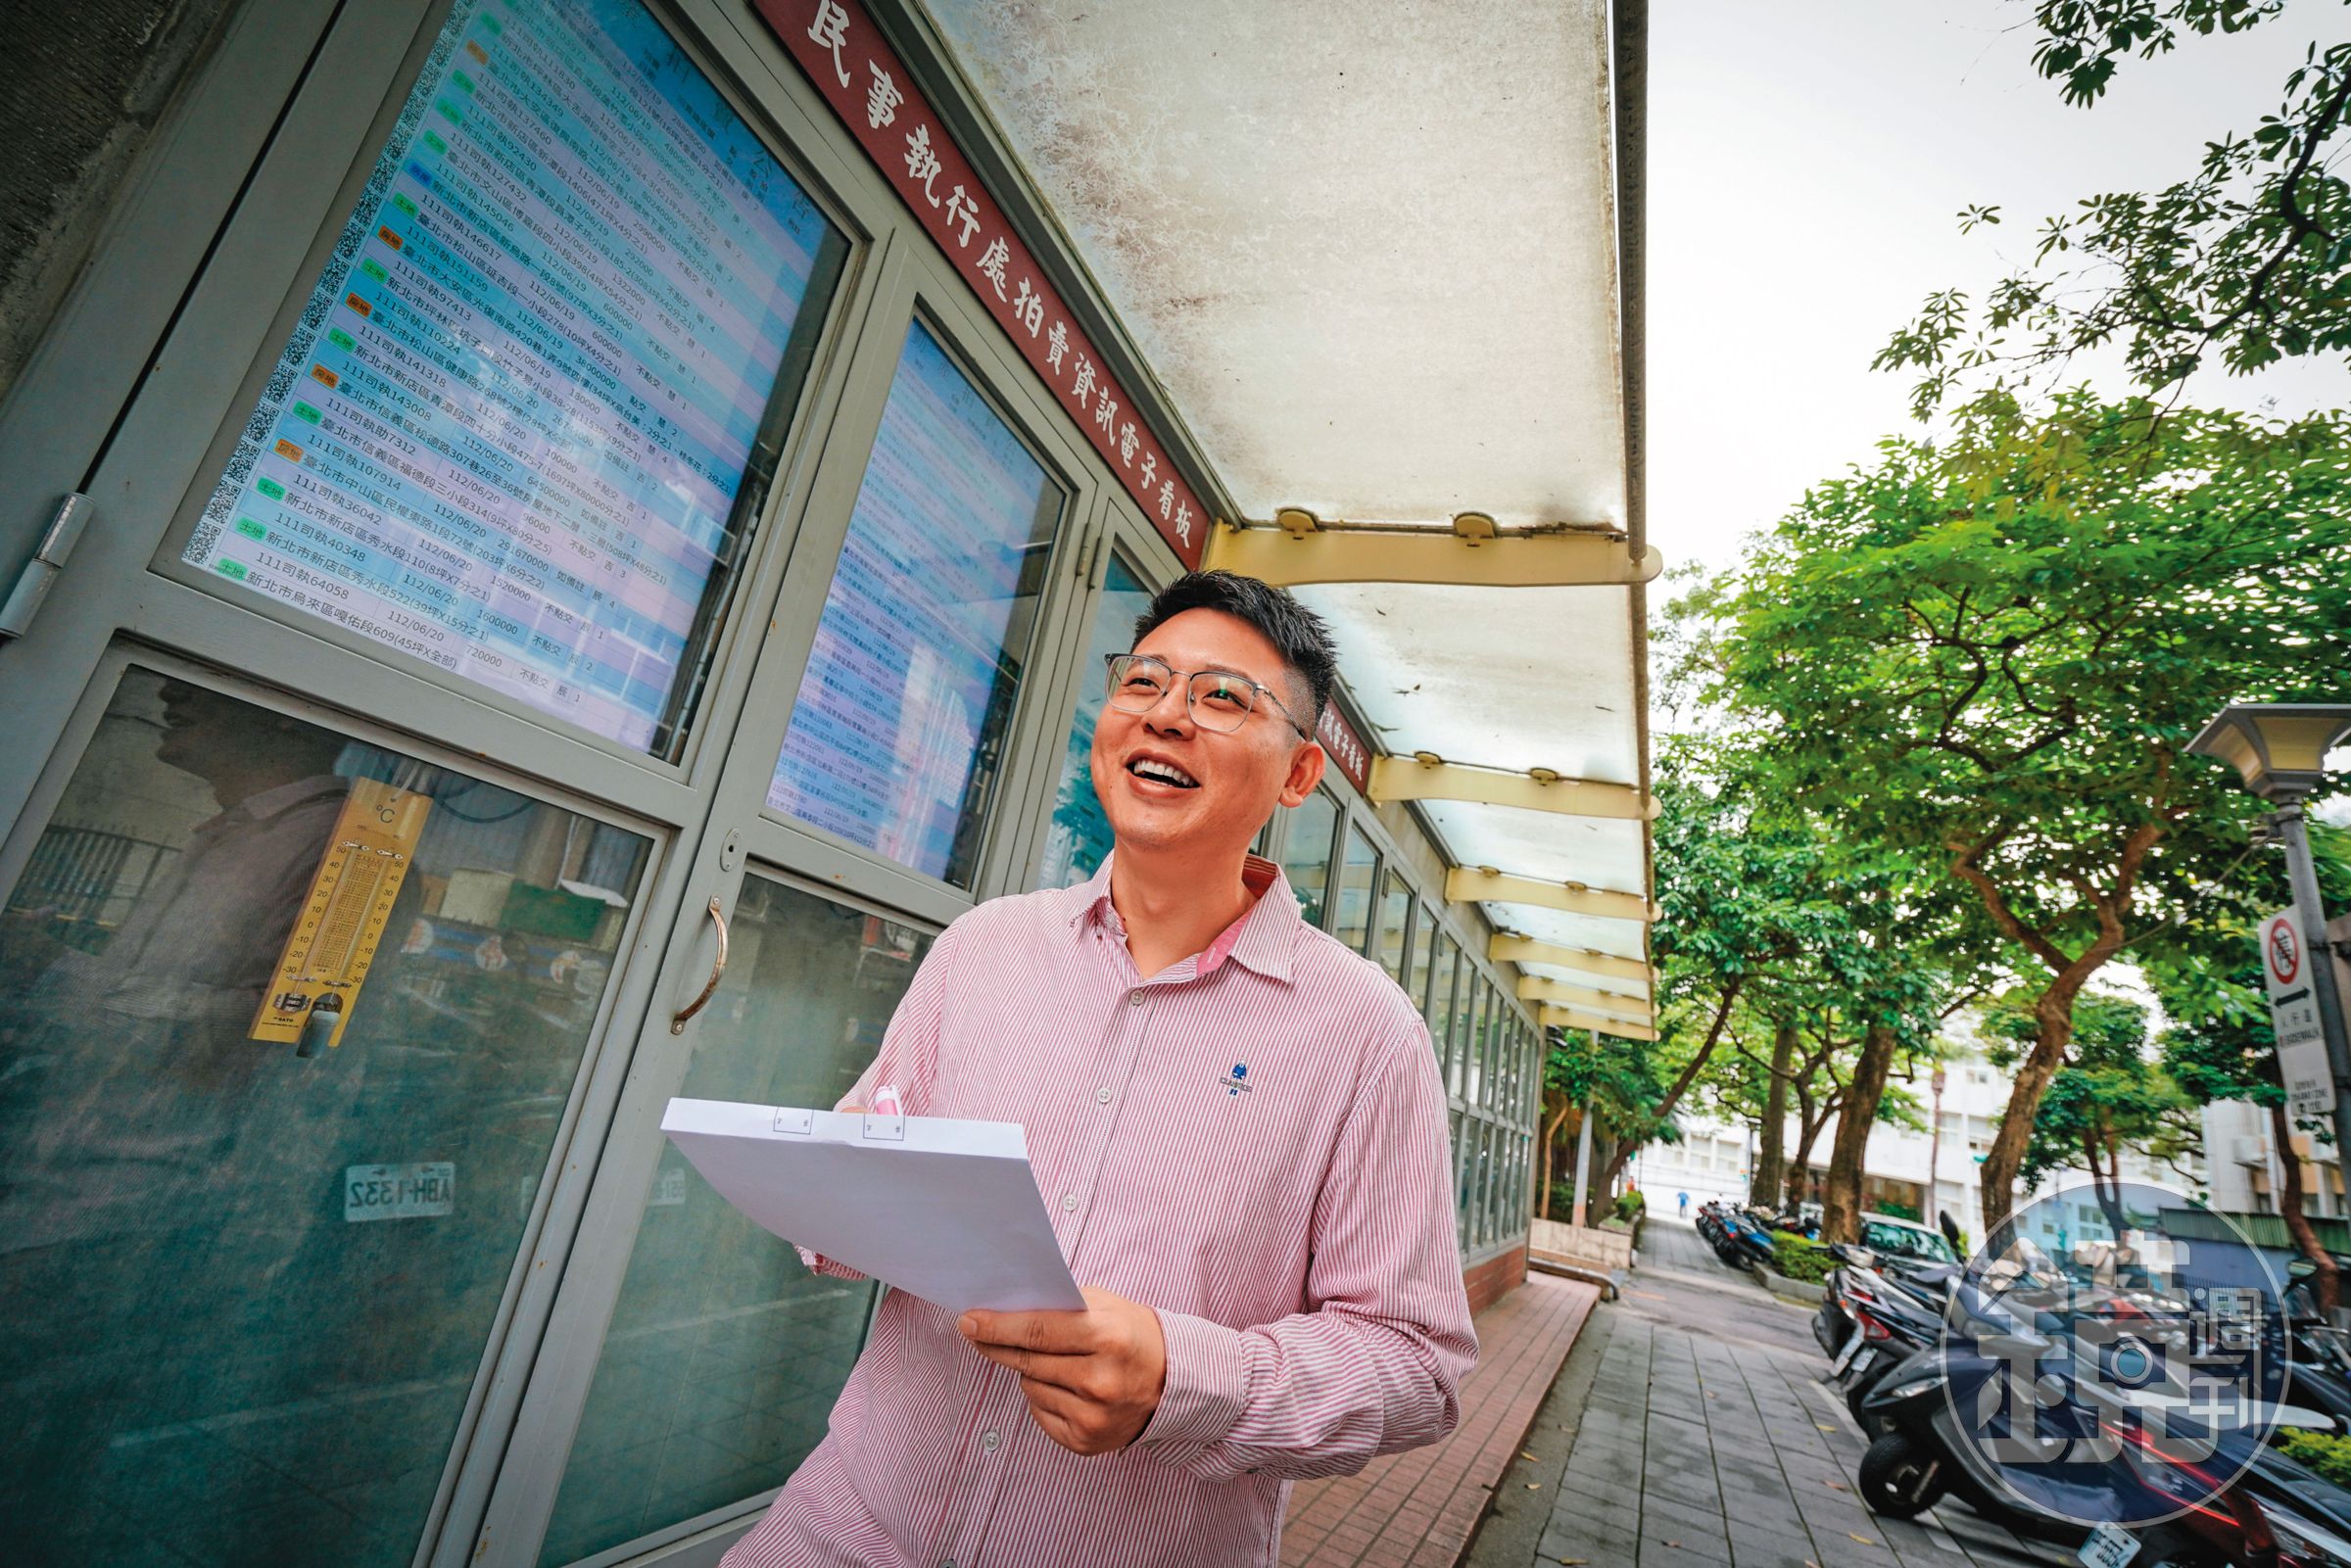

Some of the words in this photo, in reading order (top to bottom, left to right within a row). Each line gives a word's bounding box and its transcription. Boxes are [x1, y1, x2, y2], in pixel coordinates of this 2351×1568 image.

[405, 224, 489, 294] 111司執151159
[514, 309, 564, 352] 112/06/19
[574, 354, 617, 391] 38000000
[419, 192, 503, 263] 111司執146617
[527, 279, 576, 322] 112/06/19
[590, 329, 623, 359] 600000
[434, 161, 515, 234] 111司執145046
[540, 250, 587, 294] 112/06/19
[601, 301, 633, 332] 600000
[552, 221, 599, 266] 112/06/19
[807, 0, 1195, 548] 民事執行處拍賣資訊電子看板
[357, 324, 448, 390] 111司執141318
[475, 402, 527, 442] 112/06/20
[543, 447, 578, 474] 100000
[591, 477, 620, 502] 不點交
[374, 290, 461, 356] 111司執110224
[489, 369, 540, 411] 112/06/20
[393, 259, 472, 323] 111司執97413
[502, 339, 552, 381] 112/06/19
[568, 387, 601, 416] 180000
[306, 432, 403, 493] 111司執107914
[432, 501, 487, 540] 112/06/20
[324, 396, 417, 457] 111司執助7312
[447, 468, 501, 506] 112/06/20
[520, 511, 552, 535] 96000
[567, 538, 598, 562] 不點交
[340, 359, 433, 424] 111司執143008
[461, 435, 514, 474] 112/06/20
[525, 474, 571, 508] 64500000
[255, 549, 351, 601] 111司執64058
[386, 609, 446, 643] 112/06/20
[464, 644, 503, 668] 720000
[517, 667, 550, 689] 不點交
[273, 510, 367, 564] 111司執40348
[402, 573, 459, 608] 112/06/20
[475, 608, 519, 636] 1600000
[530, 634, 562, 657] 不點交
[291, 472, 383, 527] 111司執36042
[416, 537, 473, 573] 112/06/20
[489, 574, 532, 602] 1520000
[543, 600, 574, 625] 不點交
[1320, 708, 1365, 782] 訊電子看板
